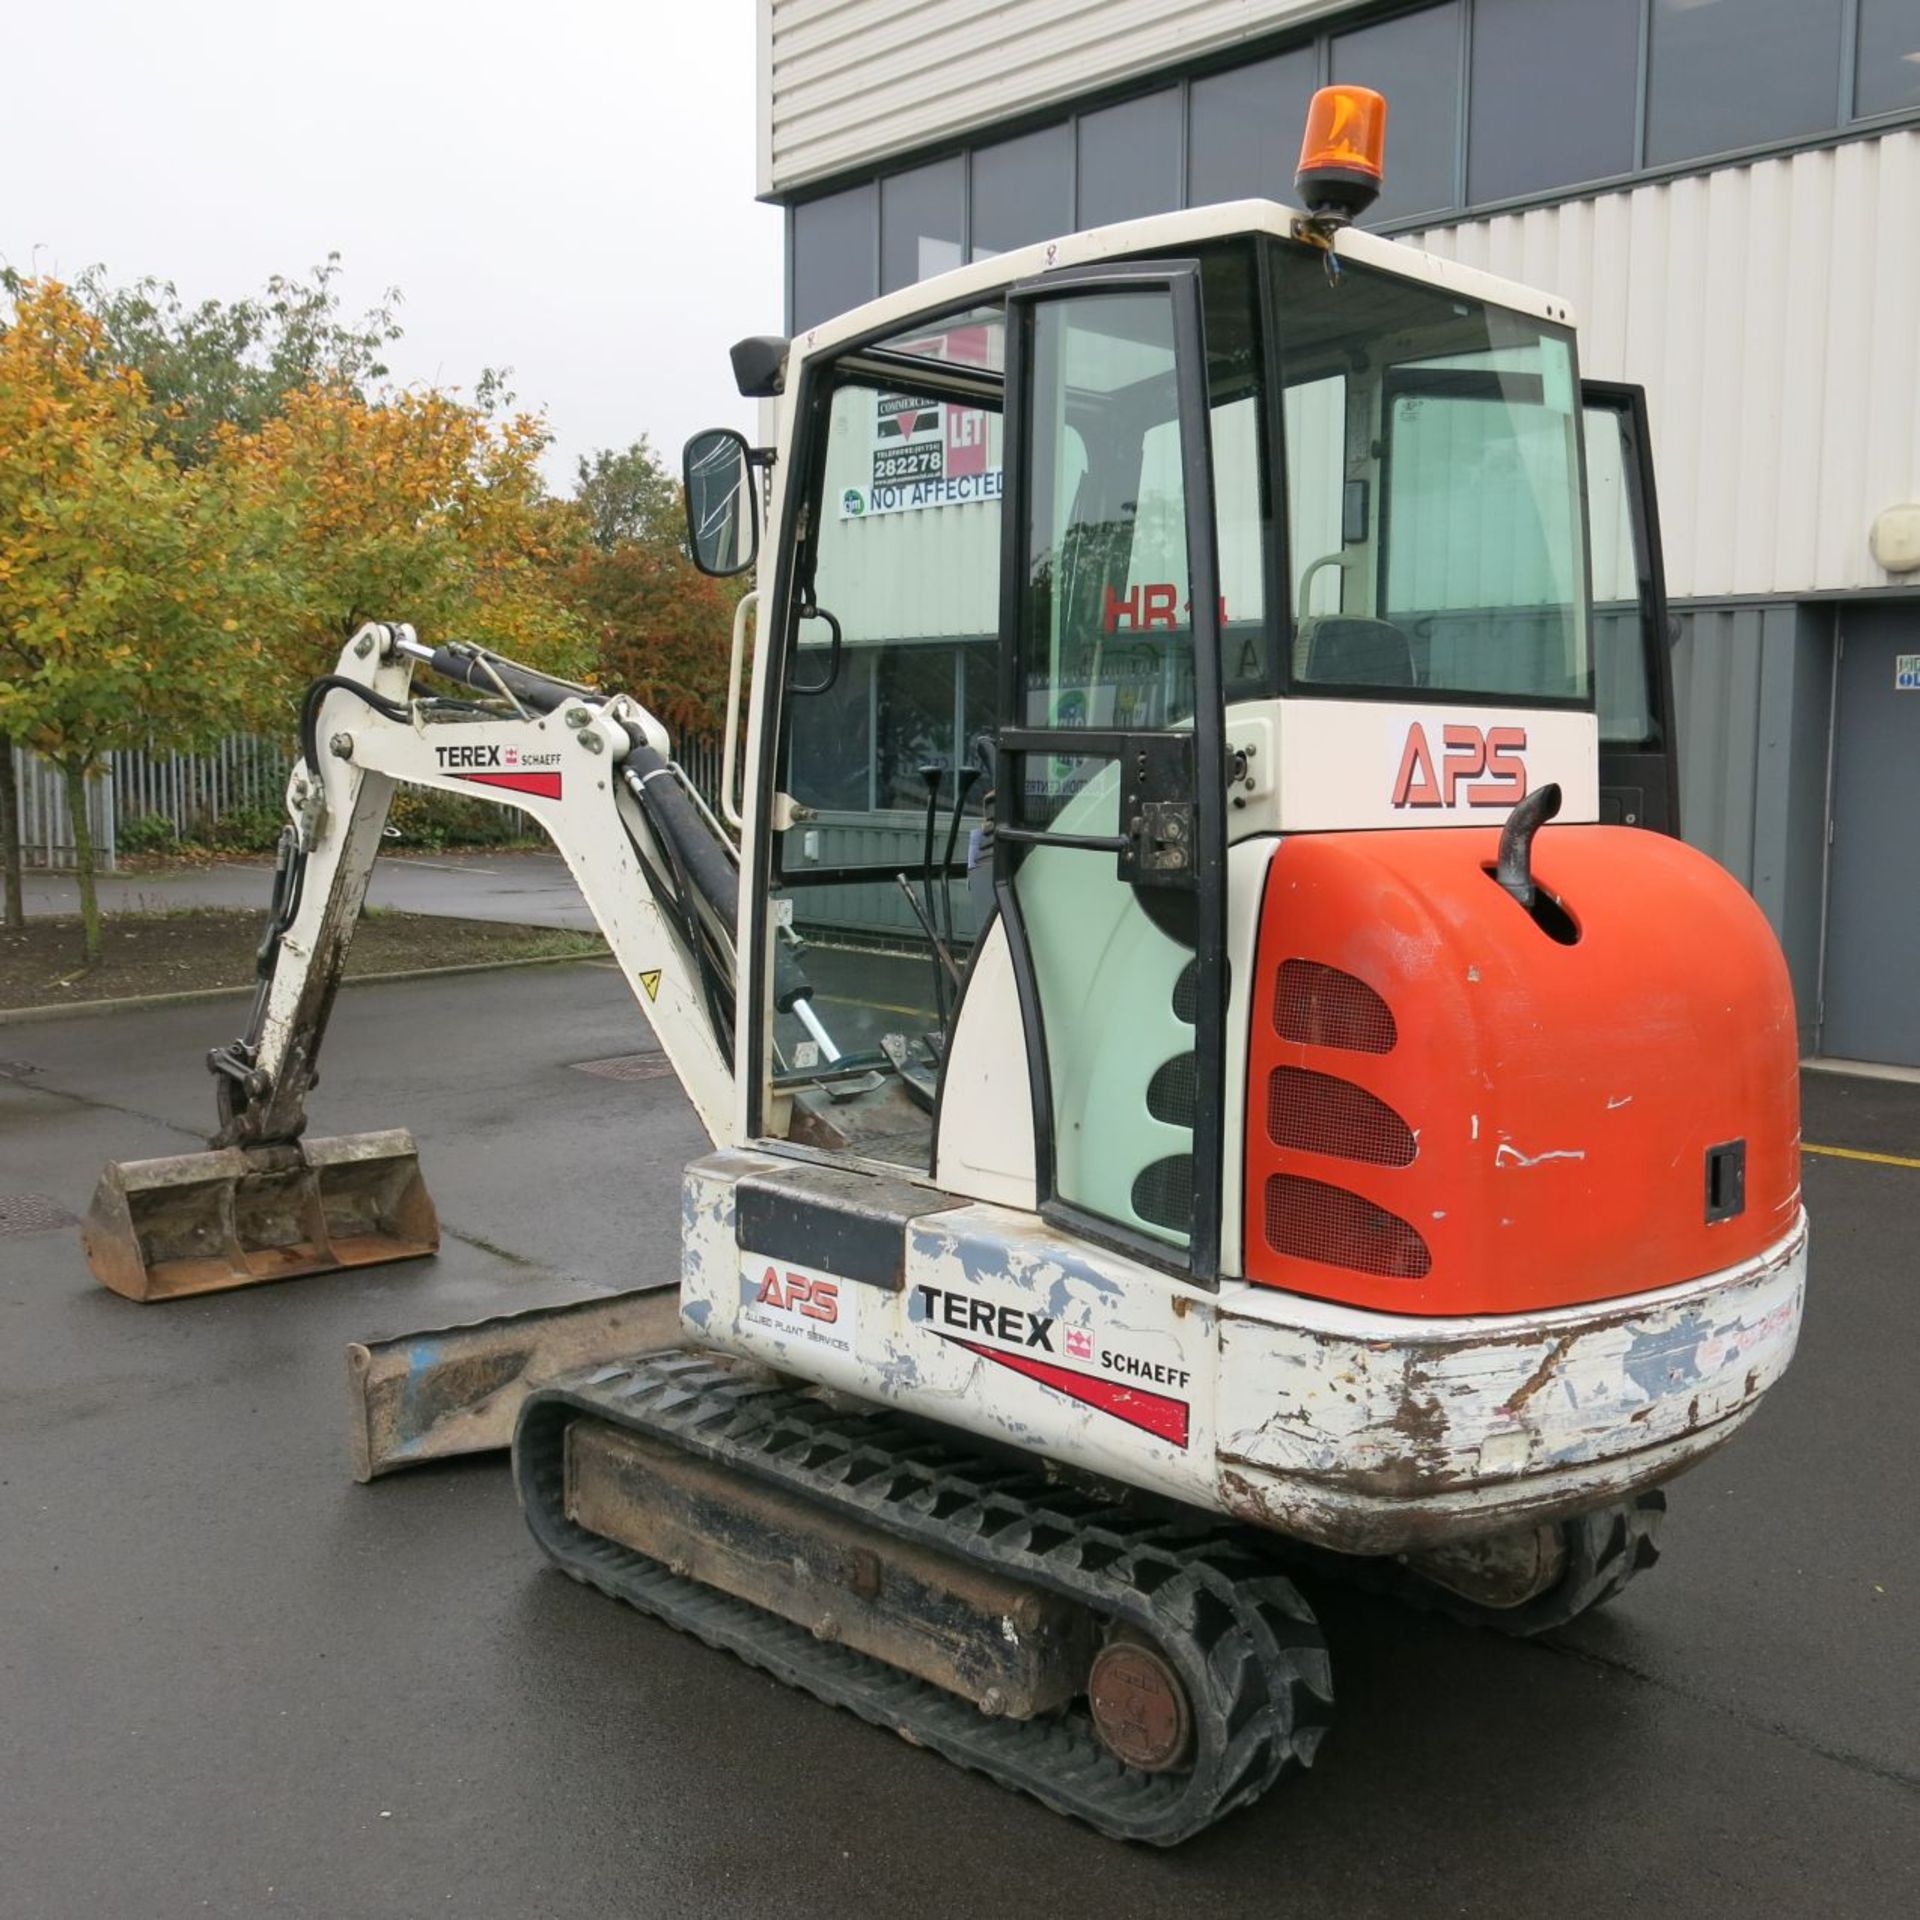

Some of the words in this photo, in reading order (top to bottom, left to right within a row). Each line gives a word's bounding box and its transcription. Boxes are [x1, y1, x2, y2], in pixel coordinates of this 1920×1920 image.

[950, 411, 984, 448] LET
[875, 452, 942, 478] 282278
[870, 485, 906, 511] NOT
[435, 744, 501, 767] TEREX
[521, 752, 562, 766] SCHAEFF
[1391, 721, 1527, 809] APS
[756, 1266, 838, 1325] APS
[775, 1321, 804, 1337] PLANT
[806, 1329, 851, 1352] SERVICES
[918, 1284, 1055, 1353] TEREX
[1101, 1351, 1191, 1389] SCHAEFF
